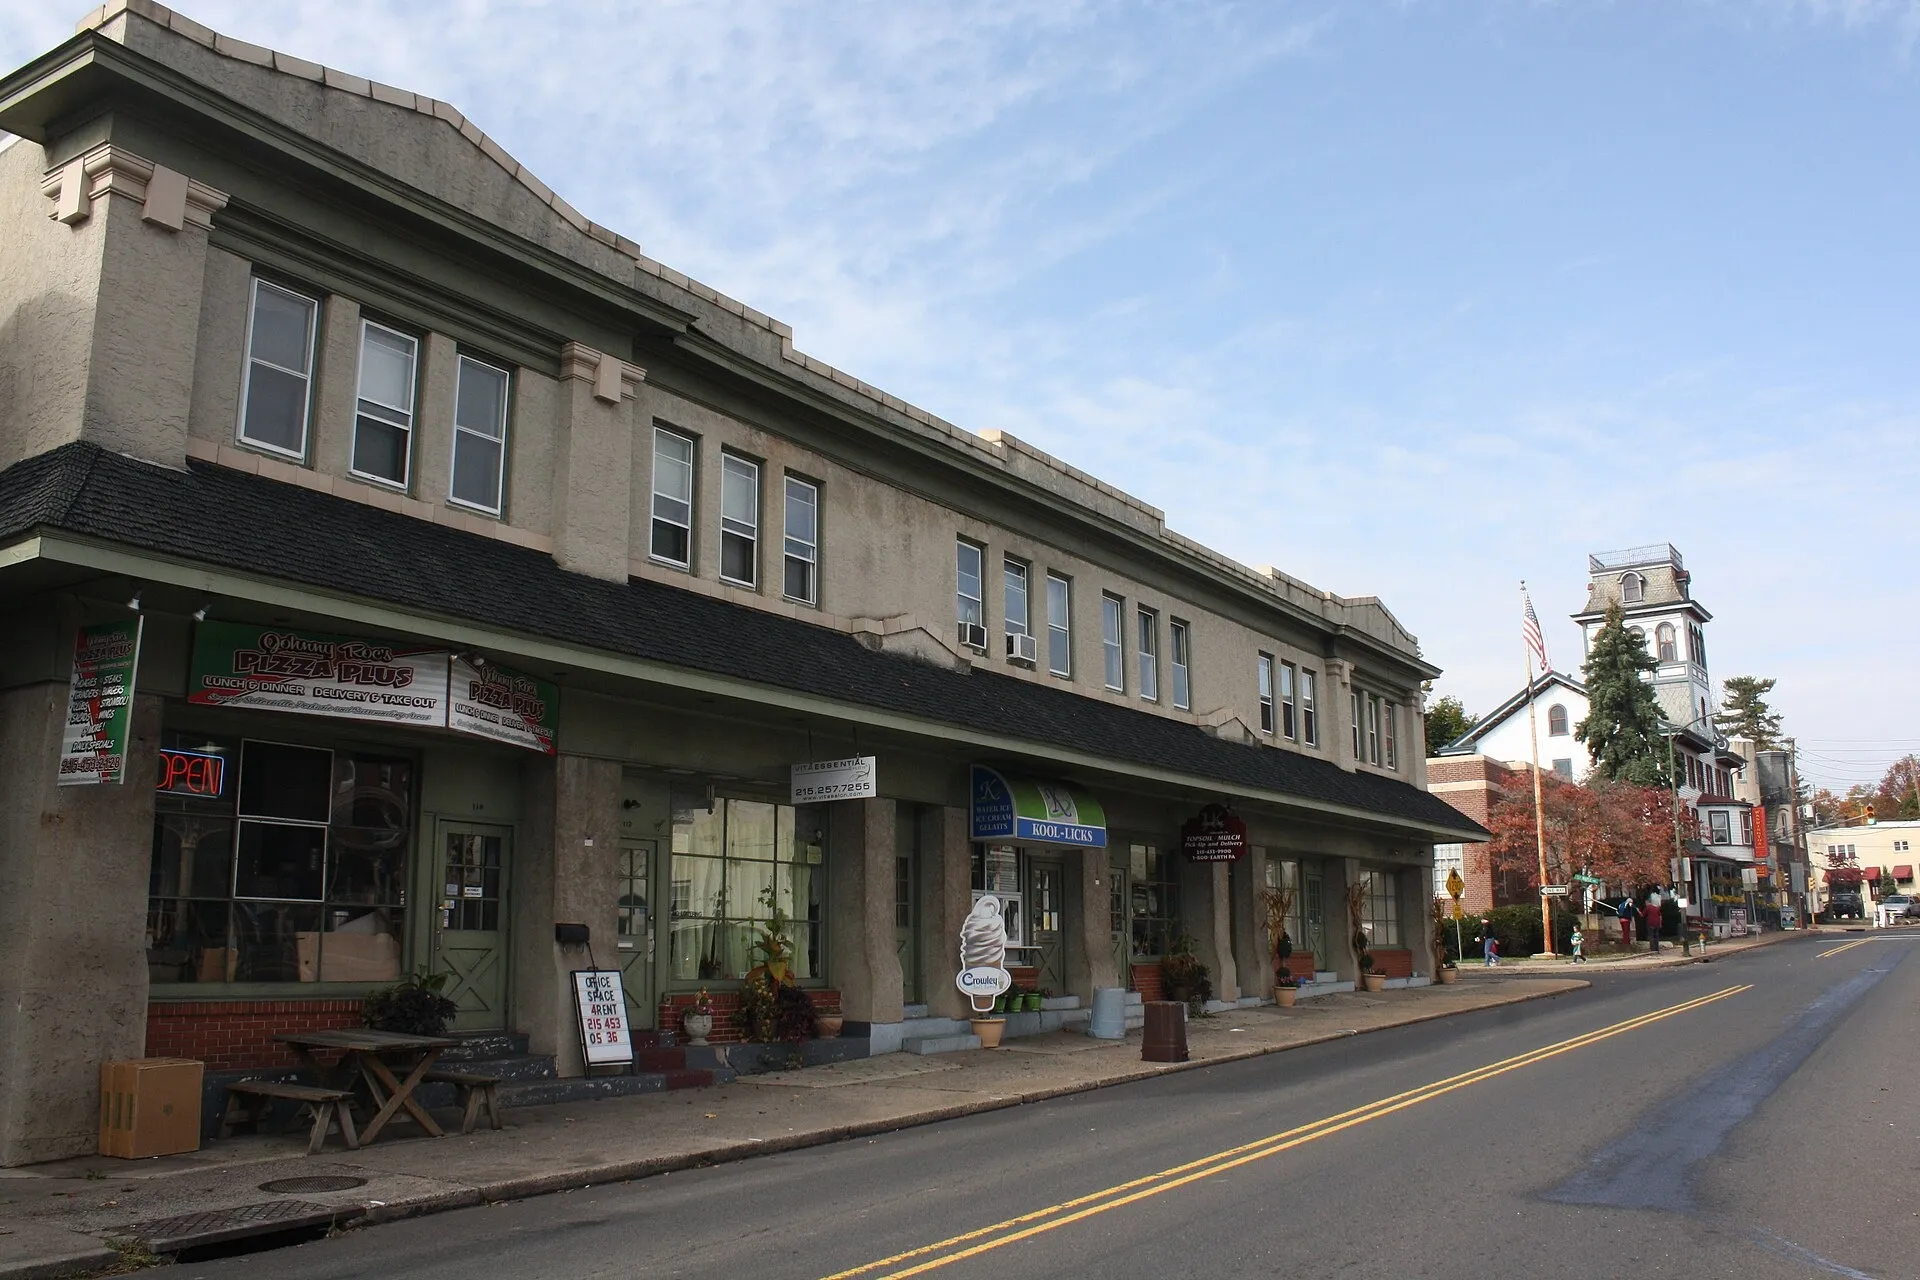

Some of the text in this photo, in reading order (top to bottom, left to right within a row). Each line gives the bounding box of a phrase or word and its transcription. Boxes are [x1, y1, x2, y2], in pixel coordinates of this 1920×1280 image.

[259, 632, 392, 662] Johnny Roc's
[234, 650, 414, 688] PIZZA PLUS
[203, 675, 436, 709] LUNCH & DINNER DELIVERY & TAKE OUT
[469, 680, 545, 722] PIZZA PLUS
[455, 702, 474, 717] LUNCH
[480, 709, 499, 724] DINNER
[796, 782, 870, 796] 215.257.7255
[976, 805, 998, 813] WATER
[975, 814, 1012, 823] ICE CREAM
[1032, 823, 1093, 842] KOOL-LICKS
[585, 976, 611, 988] OFFICE
[962, 973, 998, 985] Crowley
[587, 991, 615, 1002] SPACE
[587, 1018, 621, 1030] 215 453
